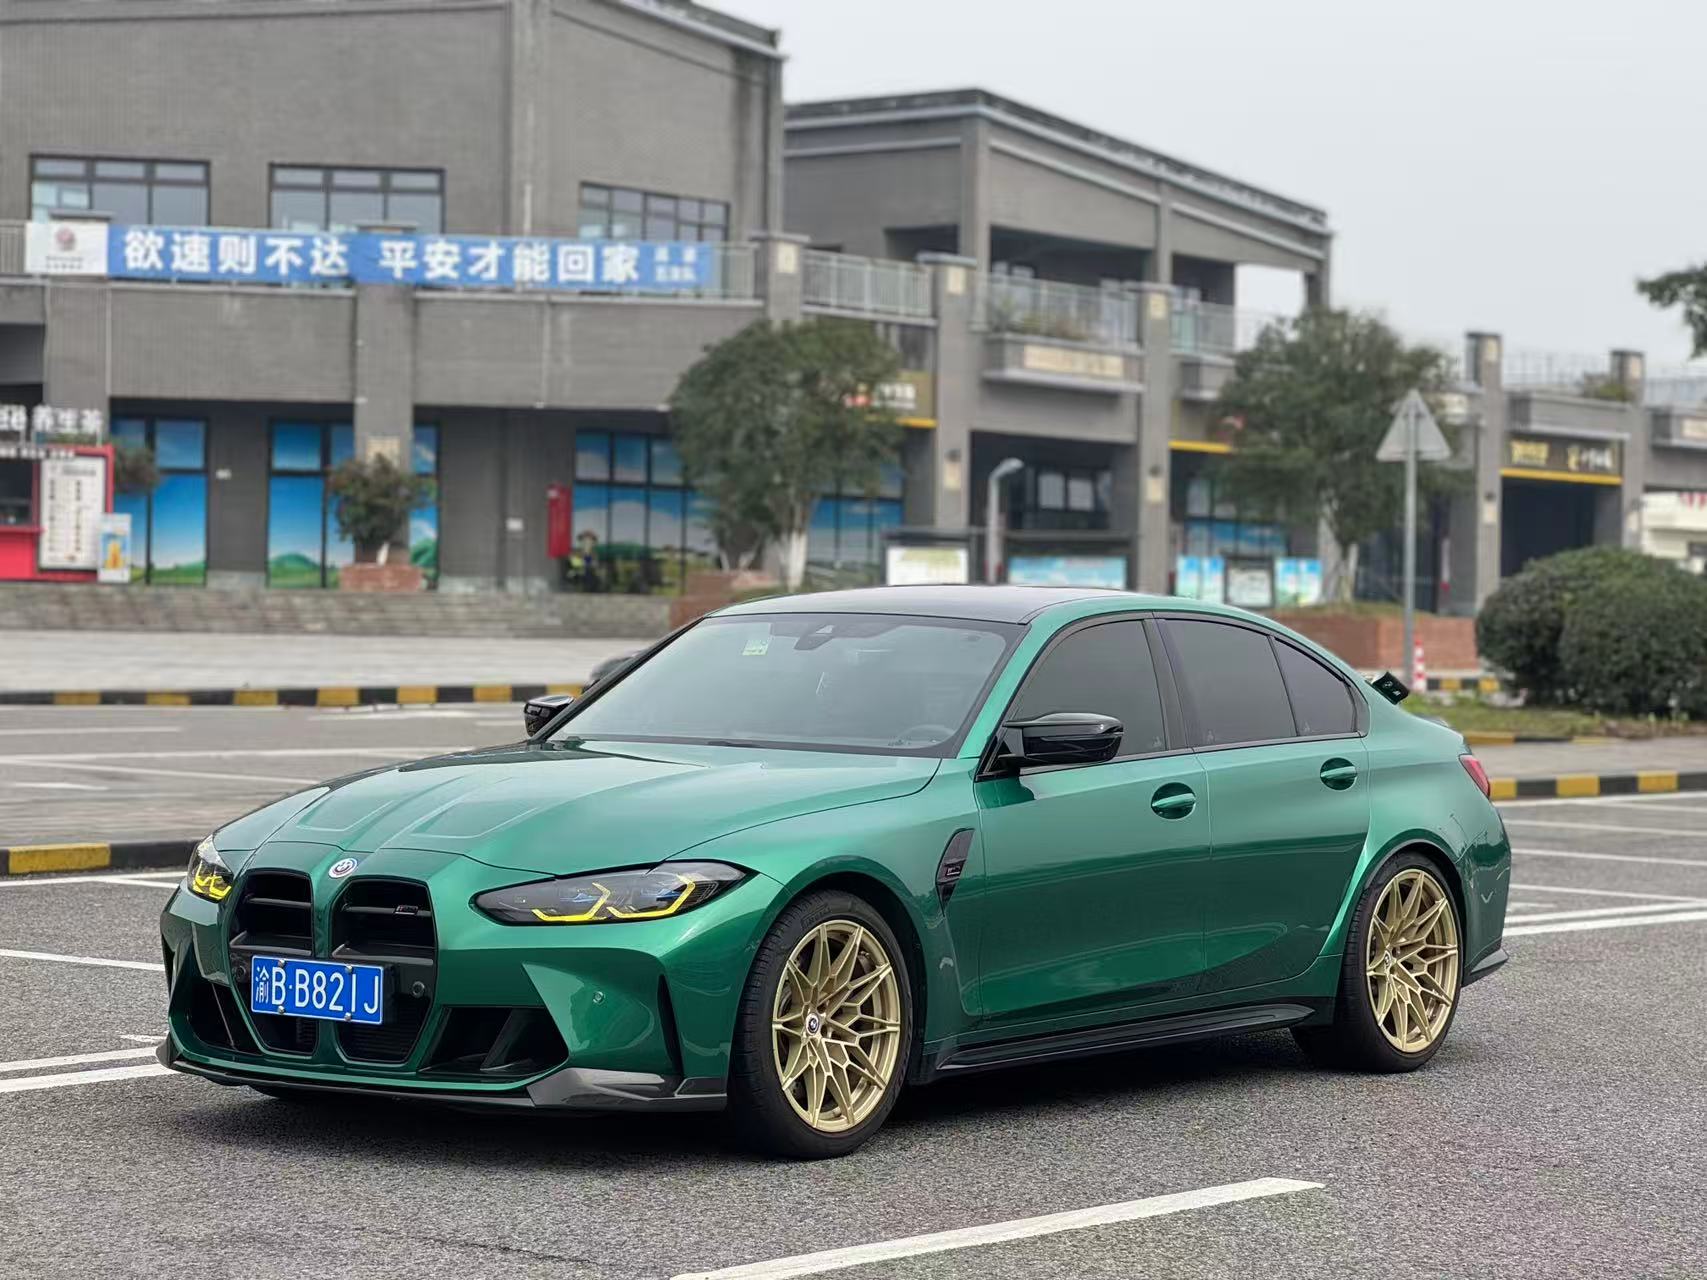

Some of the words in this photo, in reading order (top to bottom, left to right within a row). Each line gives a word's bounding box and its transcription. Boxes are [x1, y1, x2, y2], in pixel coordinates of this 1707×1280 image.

[124, 230, 348, 276] 欲速则不达
[379, 240, 639, 283] 平安才能回家
